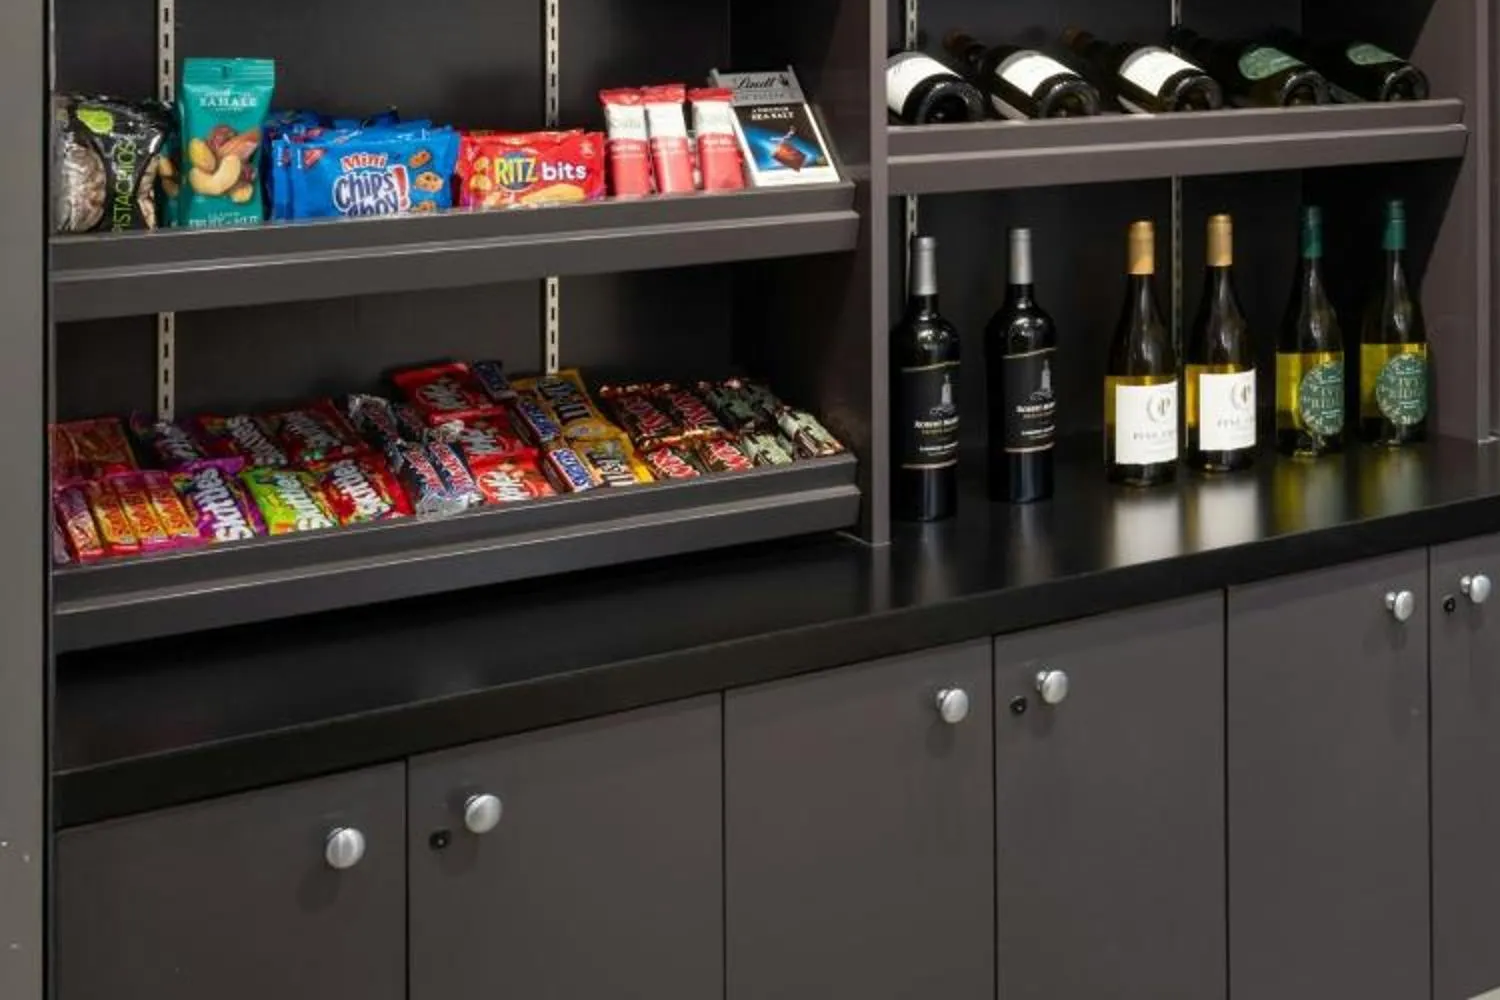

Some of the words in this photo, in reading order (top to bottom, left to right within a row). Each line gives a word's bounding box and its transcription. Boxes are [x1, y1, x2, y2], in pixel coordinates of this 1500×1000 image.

[495, 156, 540, 184] RITZ
[541, 161, 587, 182] bits
[334, 171, 395, 209] Chips
[193, 467, 254, 543] Skittles
